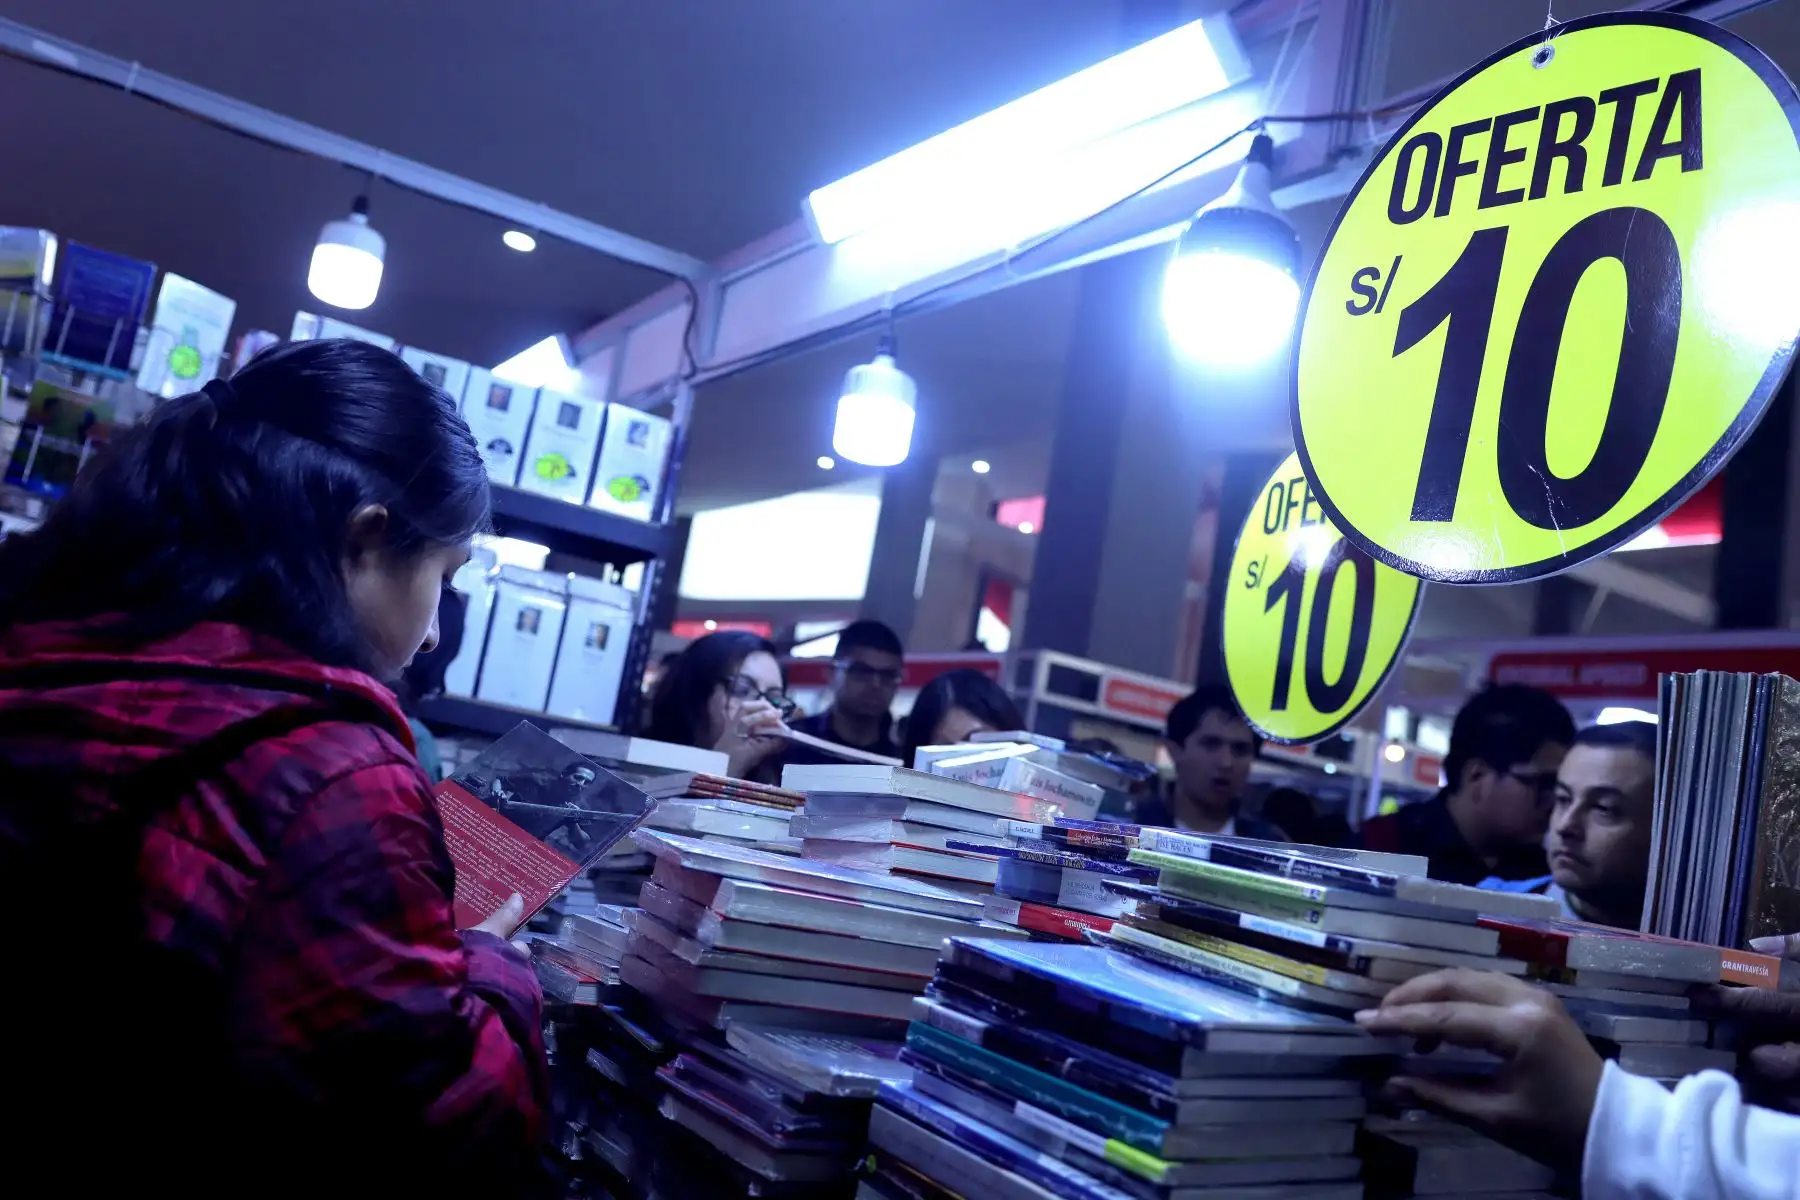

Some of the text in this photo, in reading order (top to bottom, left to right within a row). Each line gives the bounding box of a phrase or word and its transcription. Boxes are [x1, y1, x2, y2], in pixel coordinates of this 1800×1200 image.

[1387, 67, 1704, 225] OFERTA
[1345, 206, 1683, 531] S/ 10
[1263, 476, 1328, 535] OFE
[1264, 535, 1376, 715] 10
